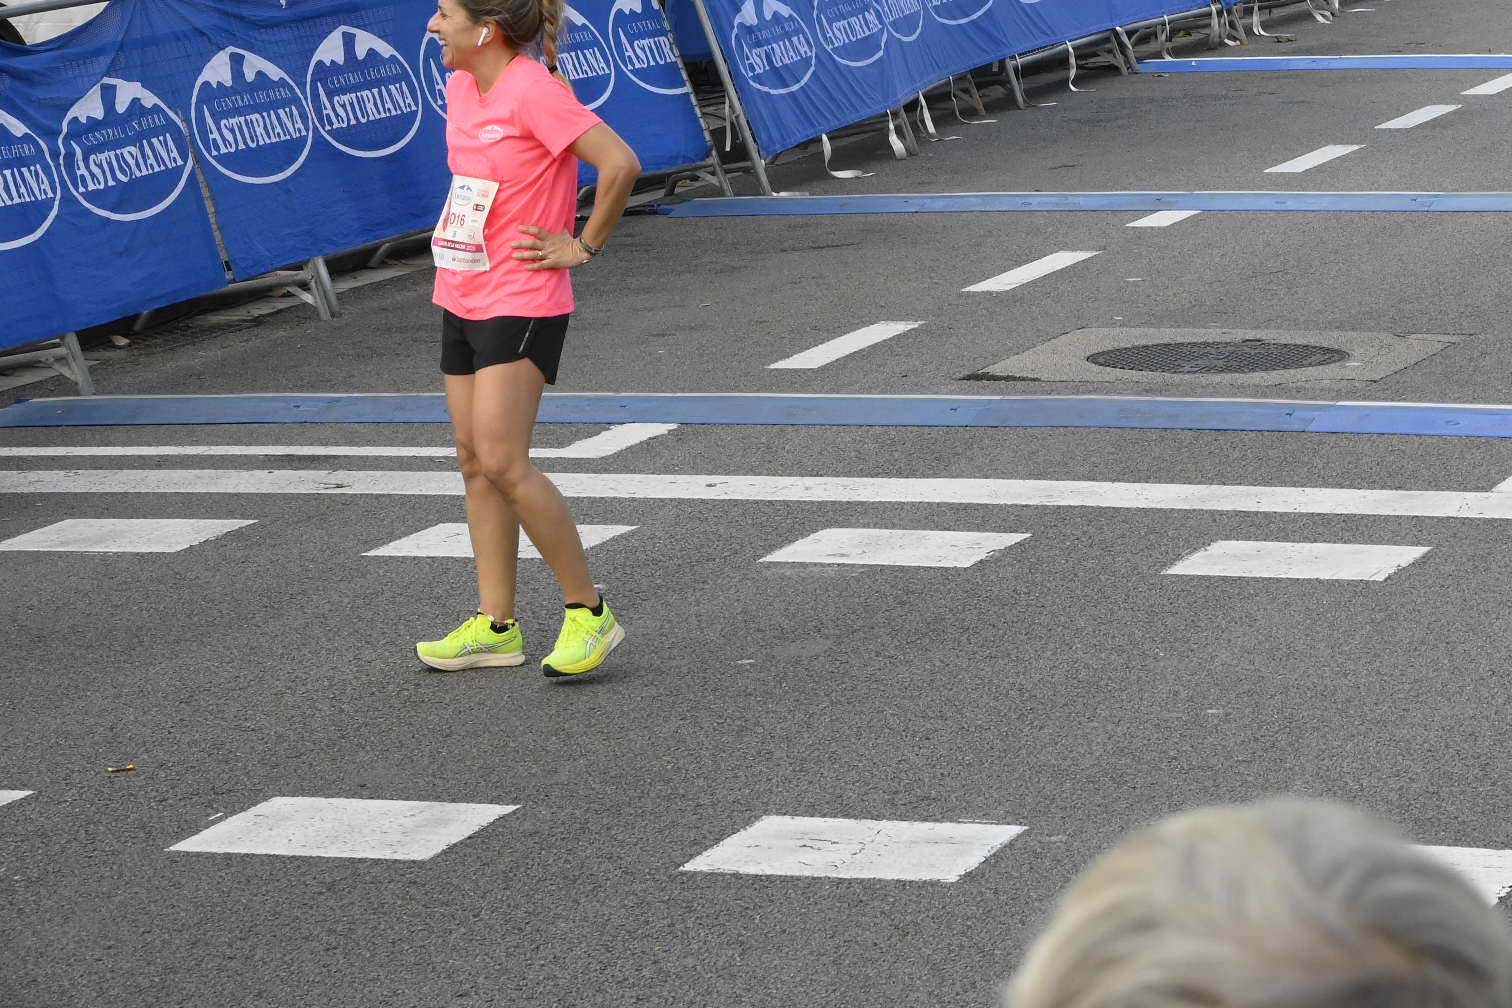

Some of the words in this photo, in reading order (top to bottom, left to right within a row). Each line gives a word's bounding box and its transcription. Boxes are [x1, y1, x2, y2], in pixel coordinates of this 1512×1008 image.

[620, 28, 680, 72] ASTUR
[327, 70, 363, 89] CENTRAL
[365, 63, 402, 81] LECHERA
[317, 81, 417, 132] ASTURIANA
[203, 104, 307, 157] ASTURIANA
